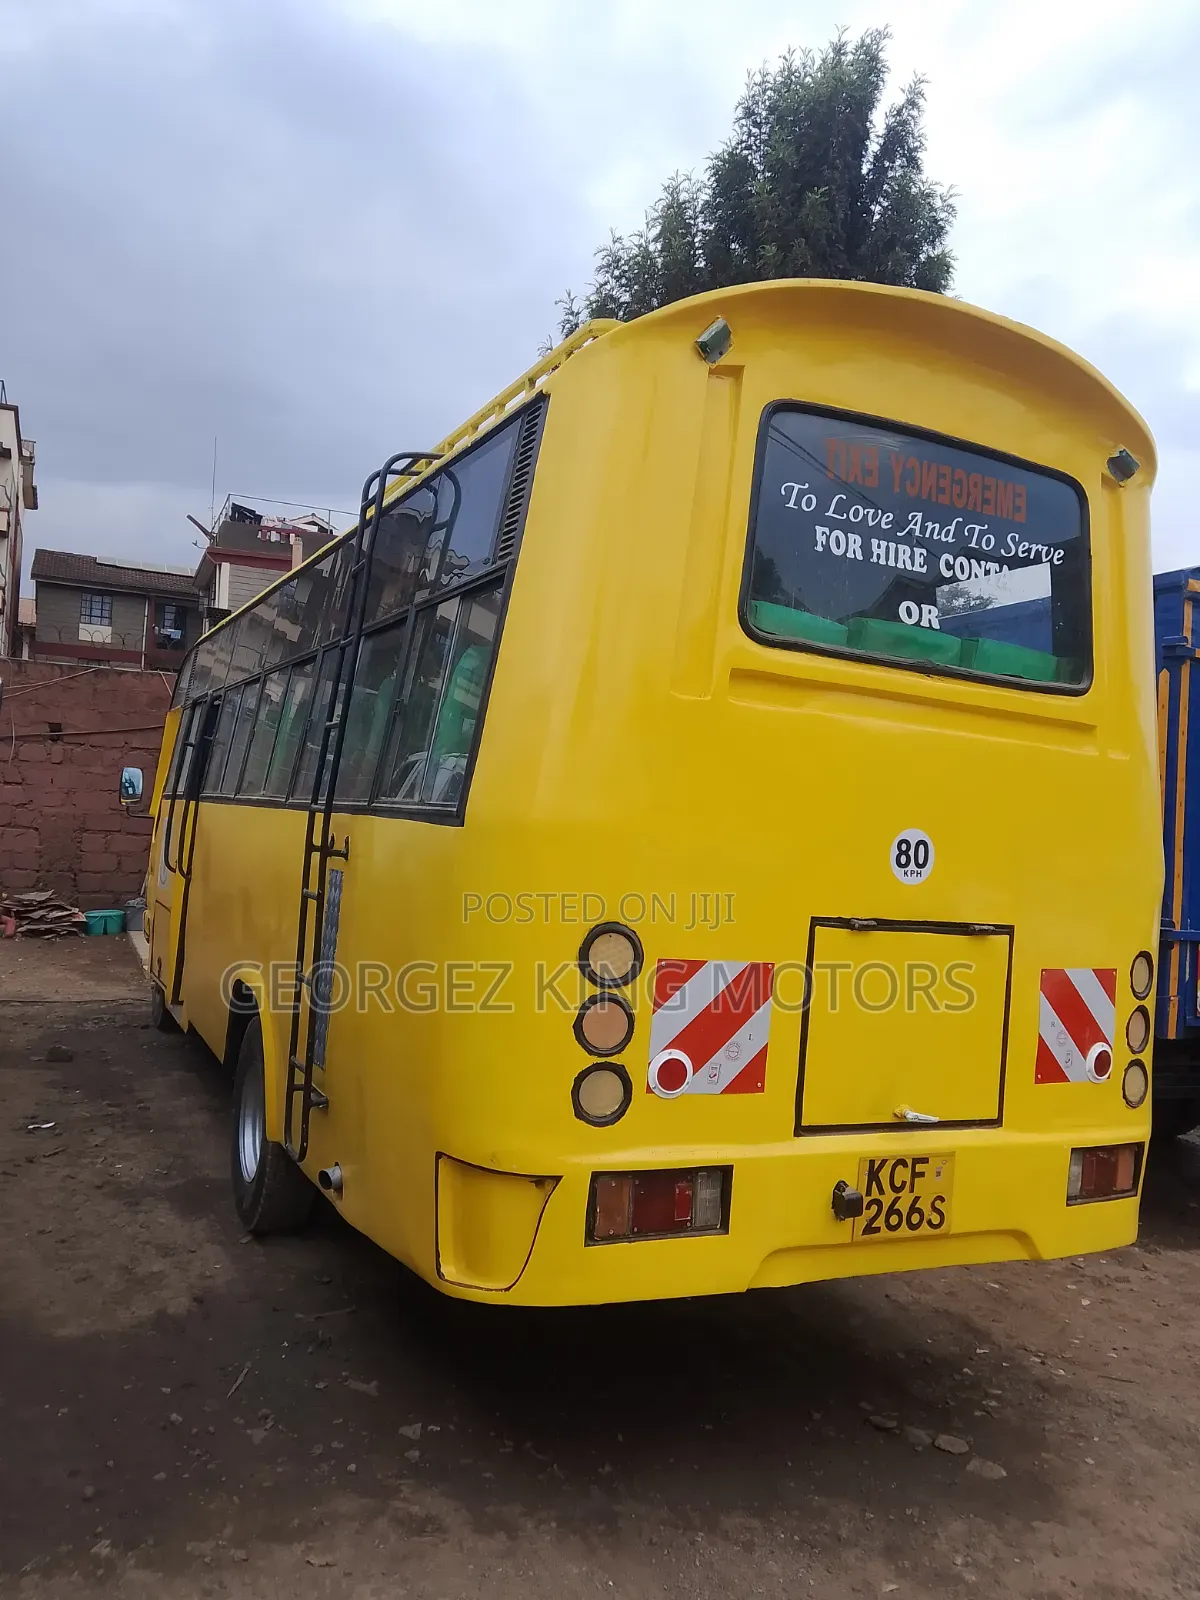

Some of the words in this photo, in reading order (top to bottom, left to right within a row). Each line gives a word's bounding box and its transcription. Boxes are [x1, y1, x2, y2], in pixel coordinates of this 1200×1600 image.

[780, 482, 818, 512] To
[825, 494, 894, 529] Love
[896, 511, 963, 544] And
[964, 523, 996, 551] To
[1000, 532, 1065, 565] Serve
[814, 525, 864, 563] FOR
[869, 538, 928, 574] HIRE
[898, 600, 941, 630] OR
[895, 838, 930, 870] 80
[903, 869, 923, 878] KPH
[865, 1157, 930, 1197] KCF
[861, 1195, 946, 1237] 266S
